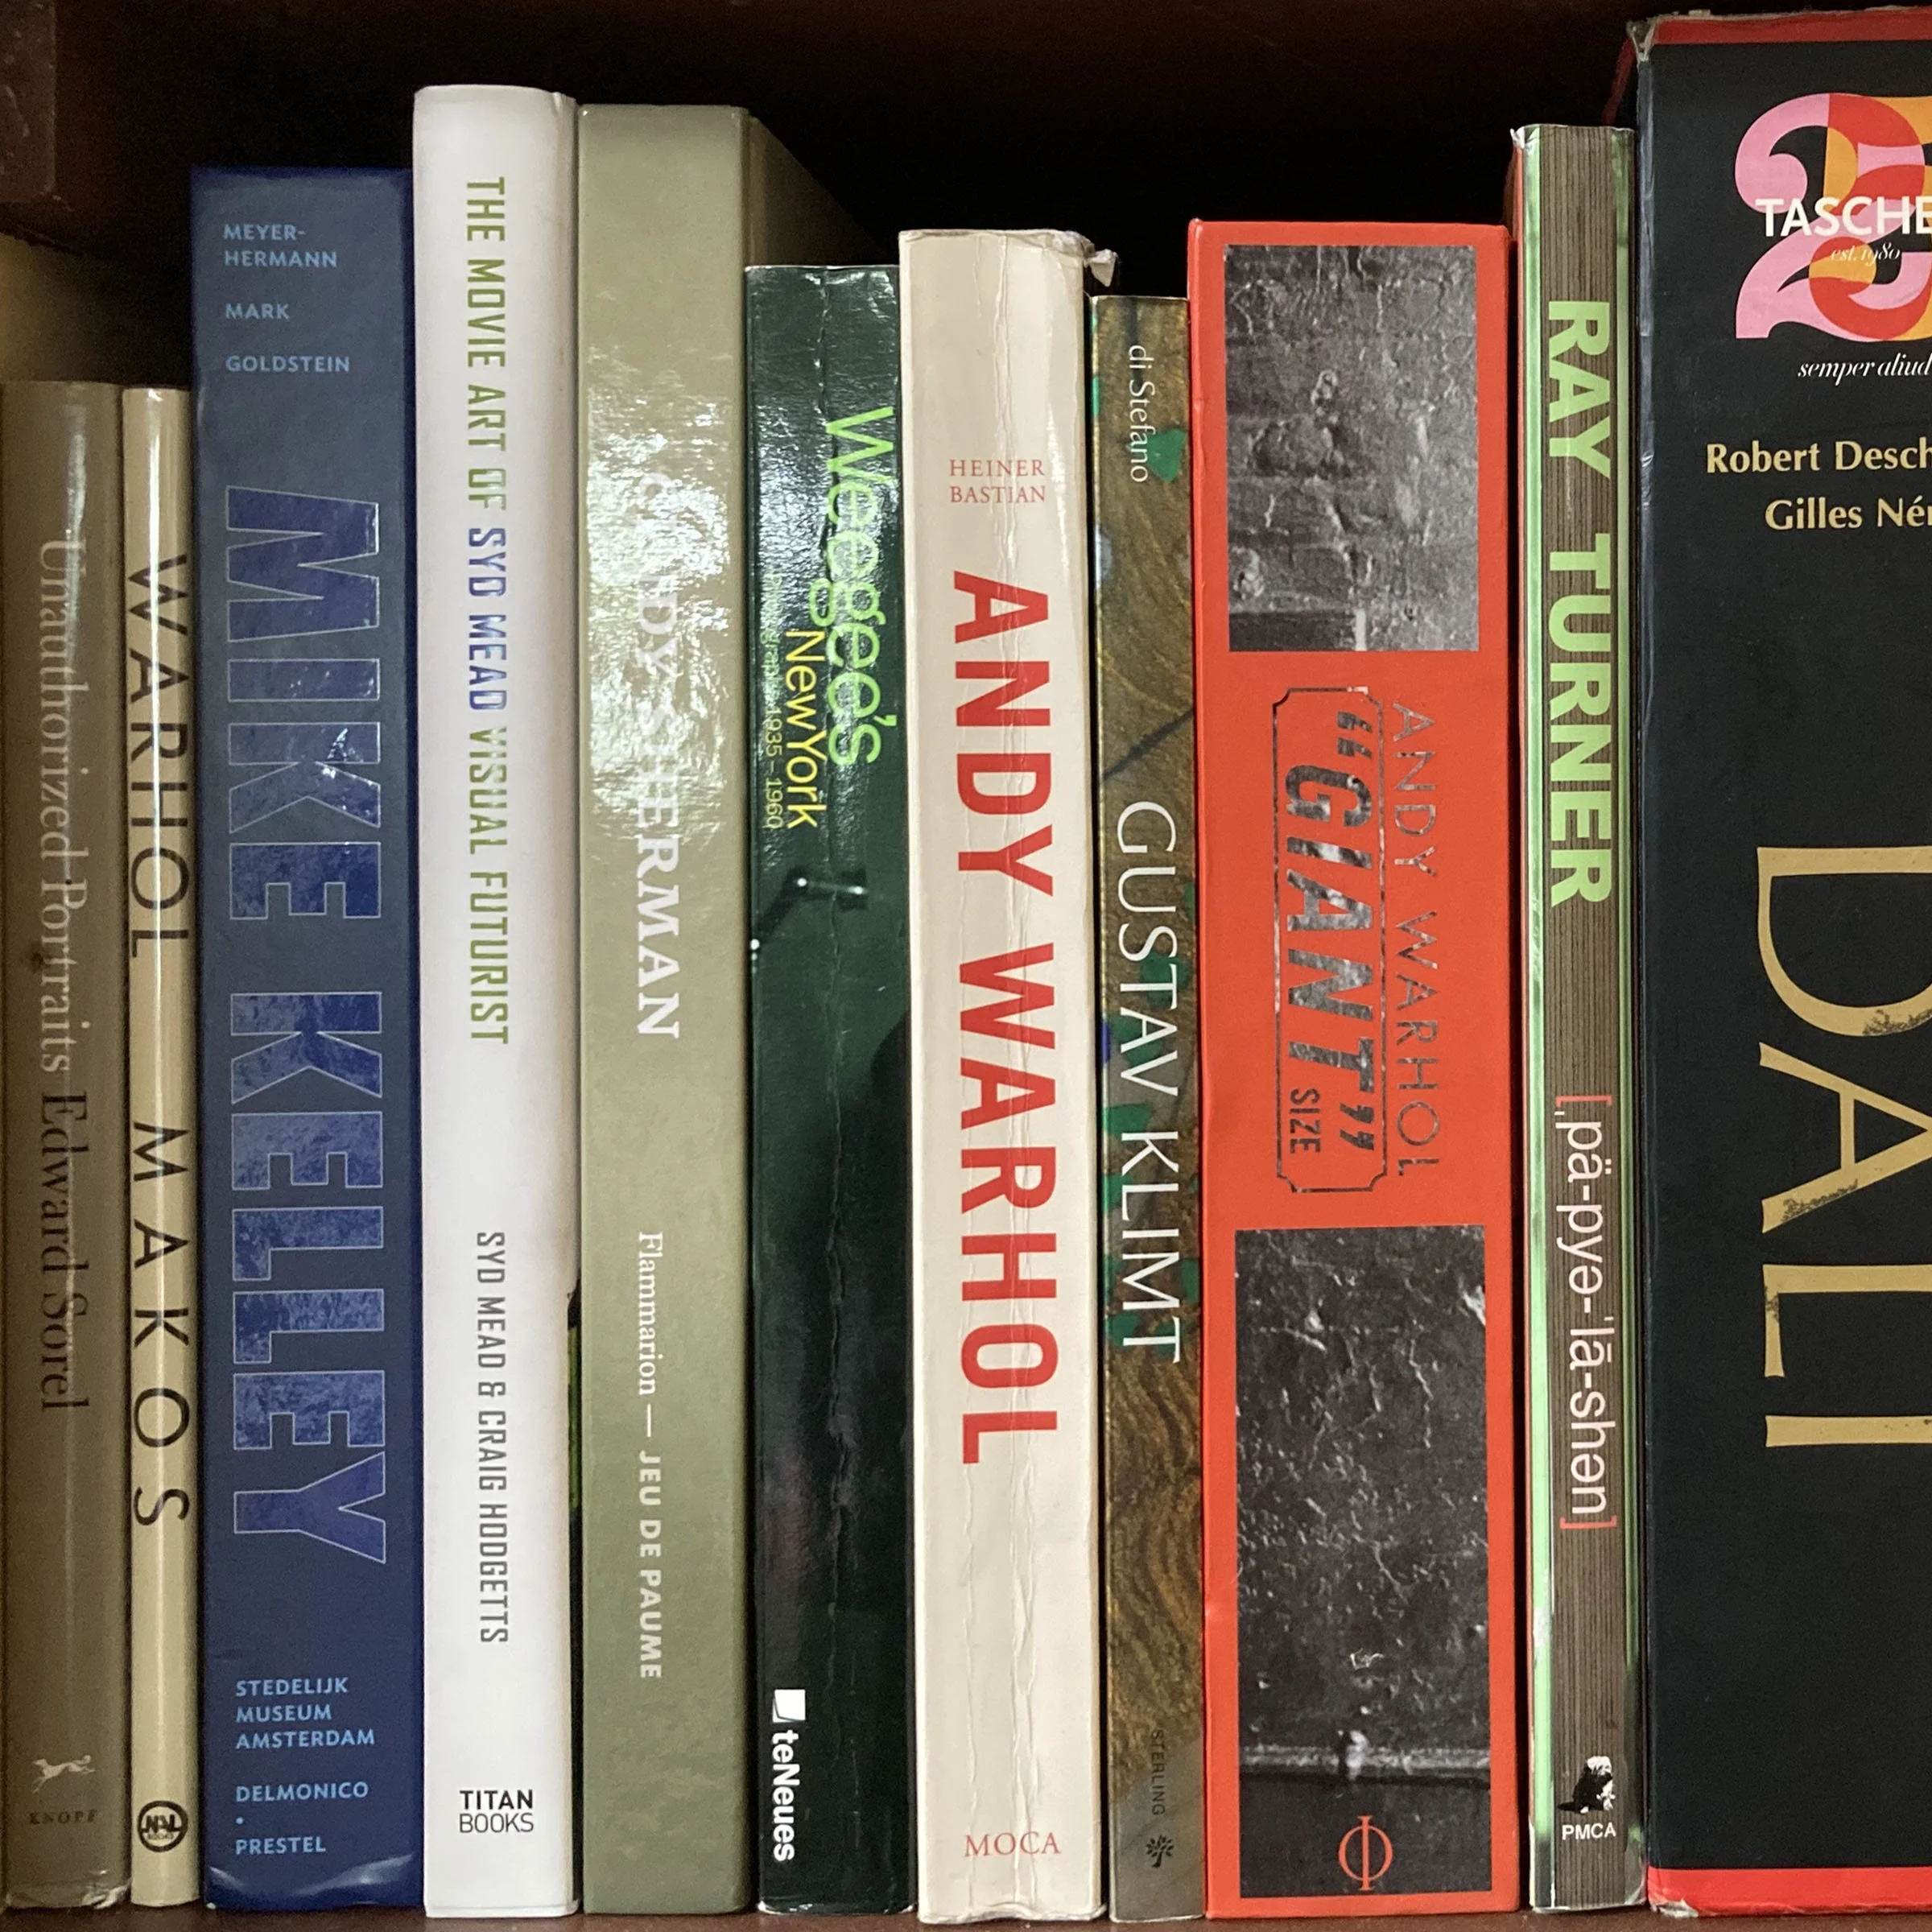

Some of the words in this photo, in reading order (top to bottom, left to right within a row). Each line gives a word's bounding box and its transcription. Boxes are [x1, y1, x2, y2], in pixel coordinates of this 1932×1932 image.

[223, 223, 307, 241] MEYER-
[466, 176, 506, 242] THE
[225, 250, 338, 268] HERMANN
[225, 303, 291, 320] MARK
[467, 259, 506, 368] MOVIE
[225, 355, 350, 372] GOLDSTEIN
[1129, 344, 1154, 373] di
[1547, 299, 1611, 480] RAY
[1797, 359, 1876, 386] semper
[1876, 351, 1932, 377] aliud
[468, 383, 506, 452] ART
[1129, 379, 1157, 483] Stefano
[468, 468, 506, 510] OF
[948, 457, 1046, 477] HEINER
[1706, 439, 1821, 473] Robert
[949, 484, 1046, 504] BASTIAN
[1764, 495, 1863, 530] Gilles
[469, 527, 506, 598] SYD
[636, 472, 679, 679] CDY
[469, 613, 507, 711] MEAD
[39, 539, 89, 867] Unauthorized
[225, 485, 381, 919] MIKE
[766, 707, 783, 757] 1935
[953, 569, 1053, 897] ANDY
[1548, 532, 1612, 906] TURNER
[126, 554, 190, 959] WARHOL
[469, 727, 508, 855] VISUAL
[1392, 702, 1437, 877] ANDY
[766, 776, 783, 831] 1960
[39, 881, 90, 1075] Portraits
[470, 872, 509, 1044] FUTURIST
[1116, 800, 1179, 1097] GUSTAV
[1396, 910, 1440, 1177] WARHOL
[1289, 1087, 1322, 1154] SIZE
[40, 1092, 90, 1274] Edward
[959, 942, 1059, 1465] WARHOL
[230, 991, 386, 1564] KELLEY
[477, 1231, 506, 1284] SYD
[1120, 1130, 1181, 1364] KLIMT
[131, 1121, 191, 1525] MAKOS
[477, 1296, 507, 1369] MEAD
[638, 1231, 663, 1396] Flammarion
[40, 1292, 90, 1410] Sorel
[477, 1381, 506, 1398] &
[478, 1410, 507, 1492] CRAIG
[638, 1451, 662, 1508] JEU
[638, 1518, 662, 1558] DE
[478, 1504, 509, 1644] HODGETTS
[638, 1568, 663, 1679] PAUME
[235, 1676, 349, 1697] STEDELIJK
[235, 1704, 332, 1724] MUSEUM
[235, 1728, 375, 1749] AMSTERDAM
[1152, 1728, 1165, 1816] STERLING
[29, 1809, 98, 1825] KNOPF
[235, 1781, 369, 1802] DELMONICO
[458, 1788, 535, 1810] TITAN
[458, 1811, 535, 1834] BOOKS
[771, 1729, 801, 1862] teNeues
[235, 1836, 327, 1856] PRESTEL
[964, 1830, 1062, 1858] MOCA
[1561, 1822, 1616, 1841] PMCA
